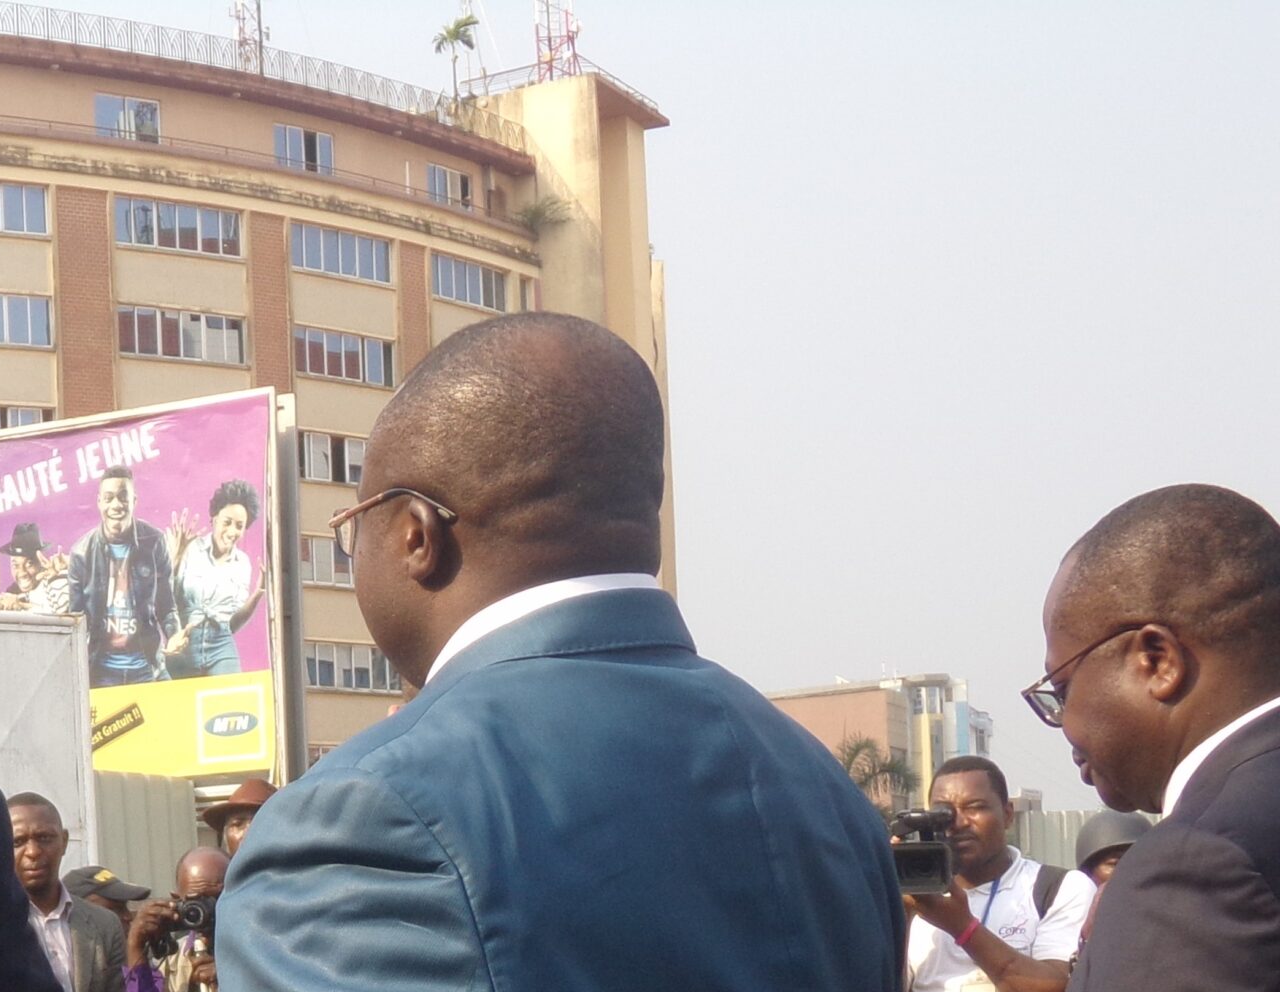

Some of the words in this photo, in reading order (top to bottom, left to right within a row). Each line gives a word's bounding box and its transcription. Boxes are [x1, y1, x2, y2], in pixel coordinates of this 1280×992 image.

[76, 423, 161, 484] JEUNE
[103, 617, 137, 635] NES
[102, 712, 134, 737] Gratuit
[212, 715, 250, 733] MTN
